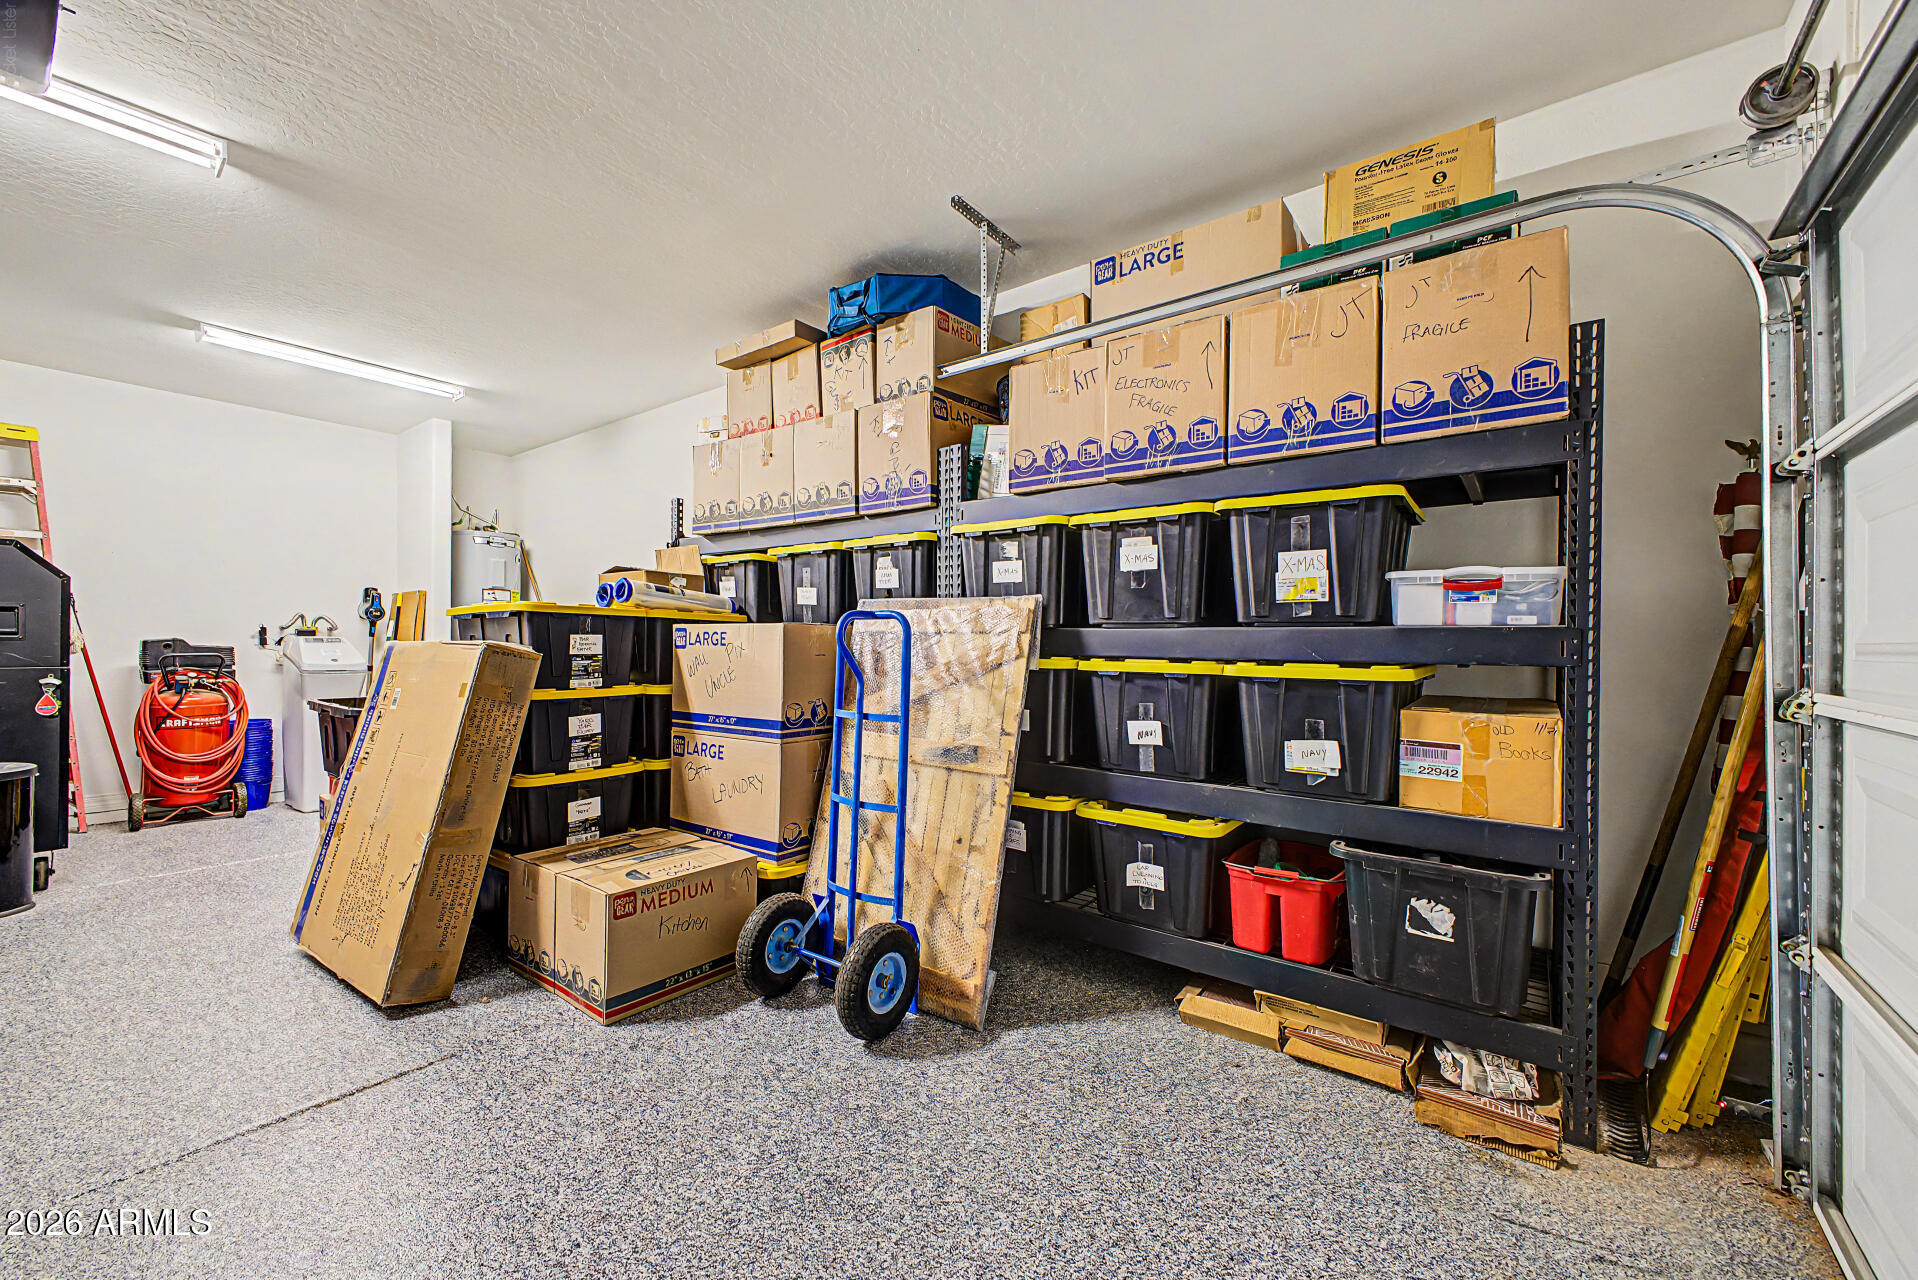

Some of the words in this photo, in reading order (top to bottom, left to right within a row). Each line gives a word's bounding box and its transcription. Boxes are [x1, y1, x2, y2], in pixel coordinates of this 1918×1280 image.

[1355, 143, 1436, 176] GENESIS
[1119, 241, 1184, 278] LARGE
[1120, 245, 1146, 260] HEAVY
[1147, 238, 1169, 250] DUTY
[1405, 276, 1431, 308] JT
[1331, 288, 1372, 338] JT
[951, 324, 981, 346] MEDIU
[1403, 318, 1471, 343] FRAGILE
[1112, 346, 1135, 366] JT
[1073, 367, 1099, 395] KIT
[1115, 376, 1191, 393] ELECTRONICS
[1129, 393, 1178, 416] FRAGILE
[1124, 553, 1155, 563] X-MAS
[1282, 554, 1326, 574] X-MAS
[688, 631, 727, 647] LARGE
[704, 665, 736, 698] UNCLE
[687, 740, 724, 760] LARGE
[1301, 748, 1327, 760] NAVY
[1498, 741, 1552, 761] Books
[1418, 765, 1459, 778] 22942
[712, 773, 764, 803] LAUNDRY
[641, 884, 665, 896] HEAVY
[666, 878, 686, 889] DUTY
[641, 878, 714, 914] MEDIUM
[658, 913, 708, 939] Kitchen
